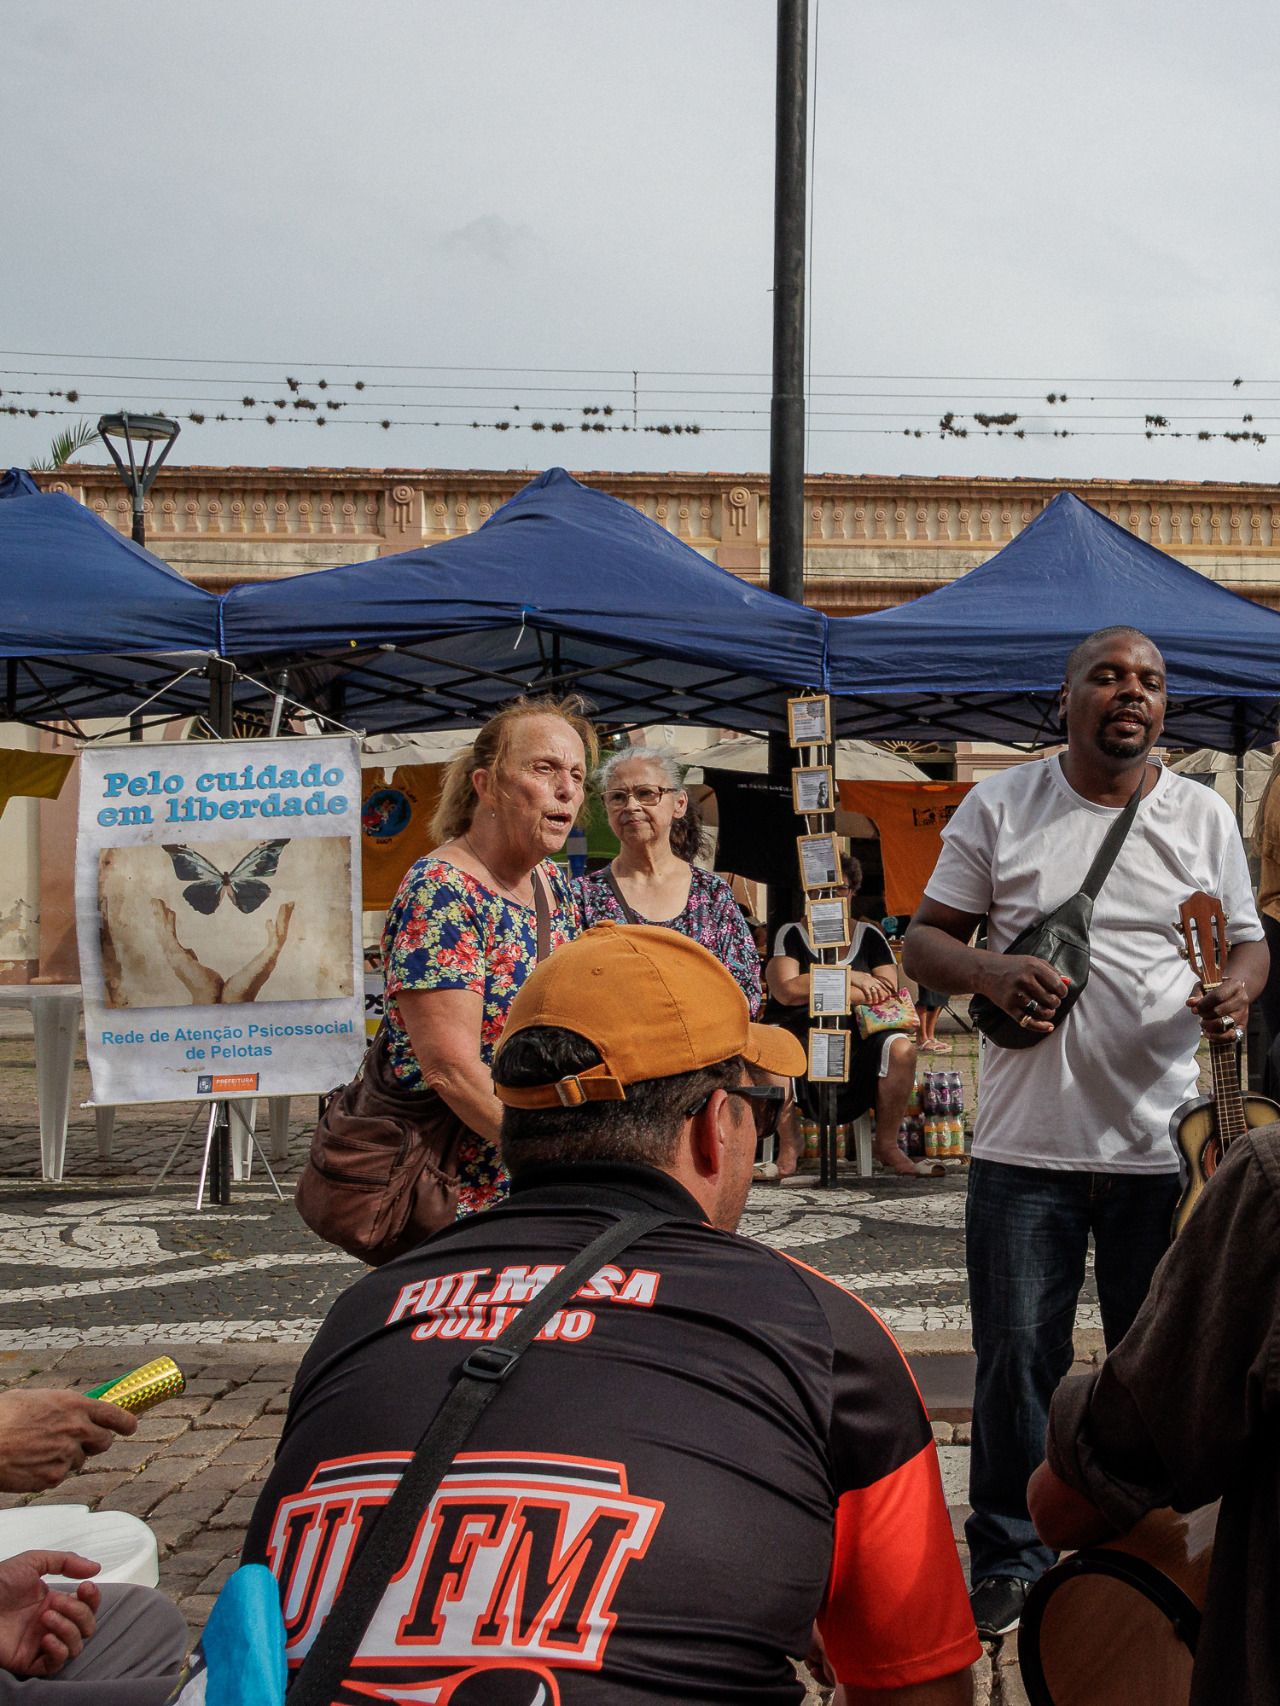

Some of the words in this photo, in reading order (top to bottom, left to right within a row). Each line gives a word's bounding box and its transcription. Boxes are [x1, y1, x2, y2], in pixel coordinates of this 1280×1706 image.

[103, 770, 184, 798] Pelo
[196, 763, 345, 793] cuidado
[97, 803, 155, 827] em
[165, 791, 349, 823] liberdade
[102, 1030, 145, 1045] Rede
[150, 1029, 170, 1043] de
[174, 1025, 243, 1043] Atenção
[248, 1019, 353, 1038] Psicossocial
[186, 1046, 206, 1060] de
[211, 1044, 273, 1059] Pelotas
[216, 1077, 254, 1085] PREFEITURA
[385, 1264, 661, 1327] FUT.MSA
[411, 1305, 596, 1342] JULINO
